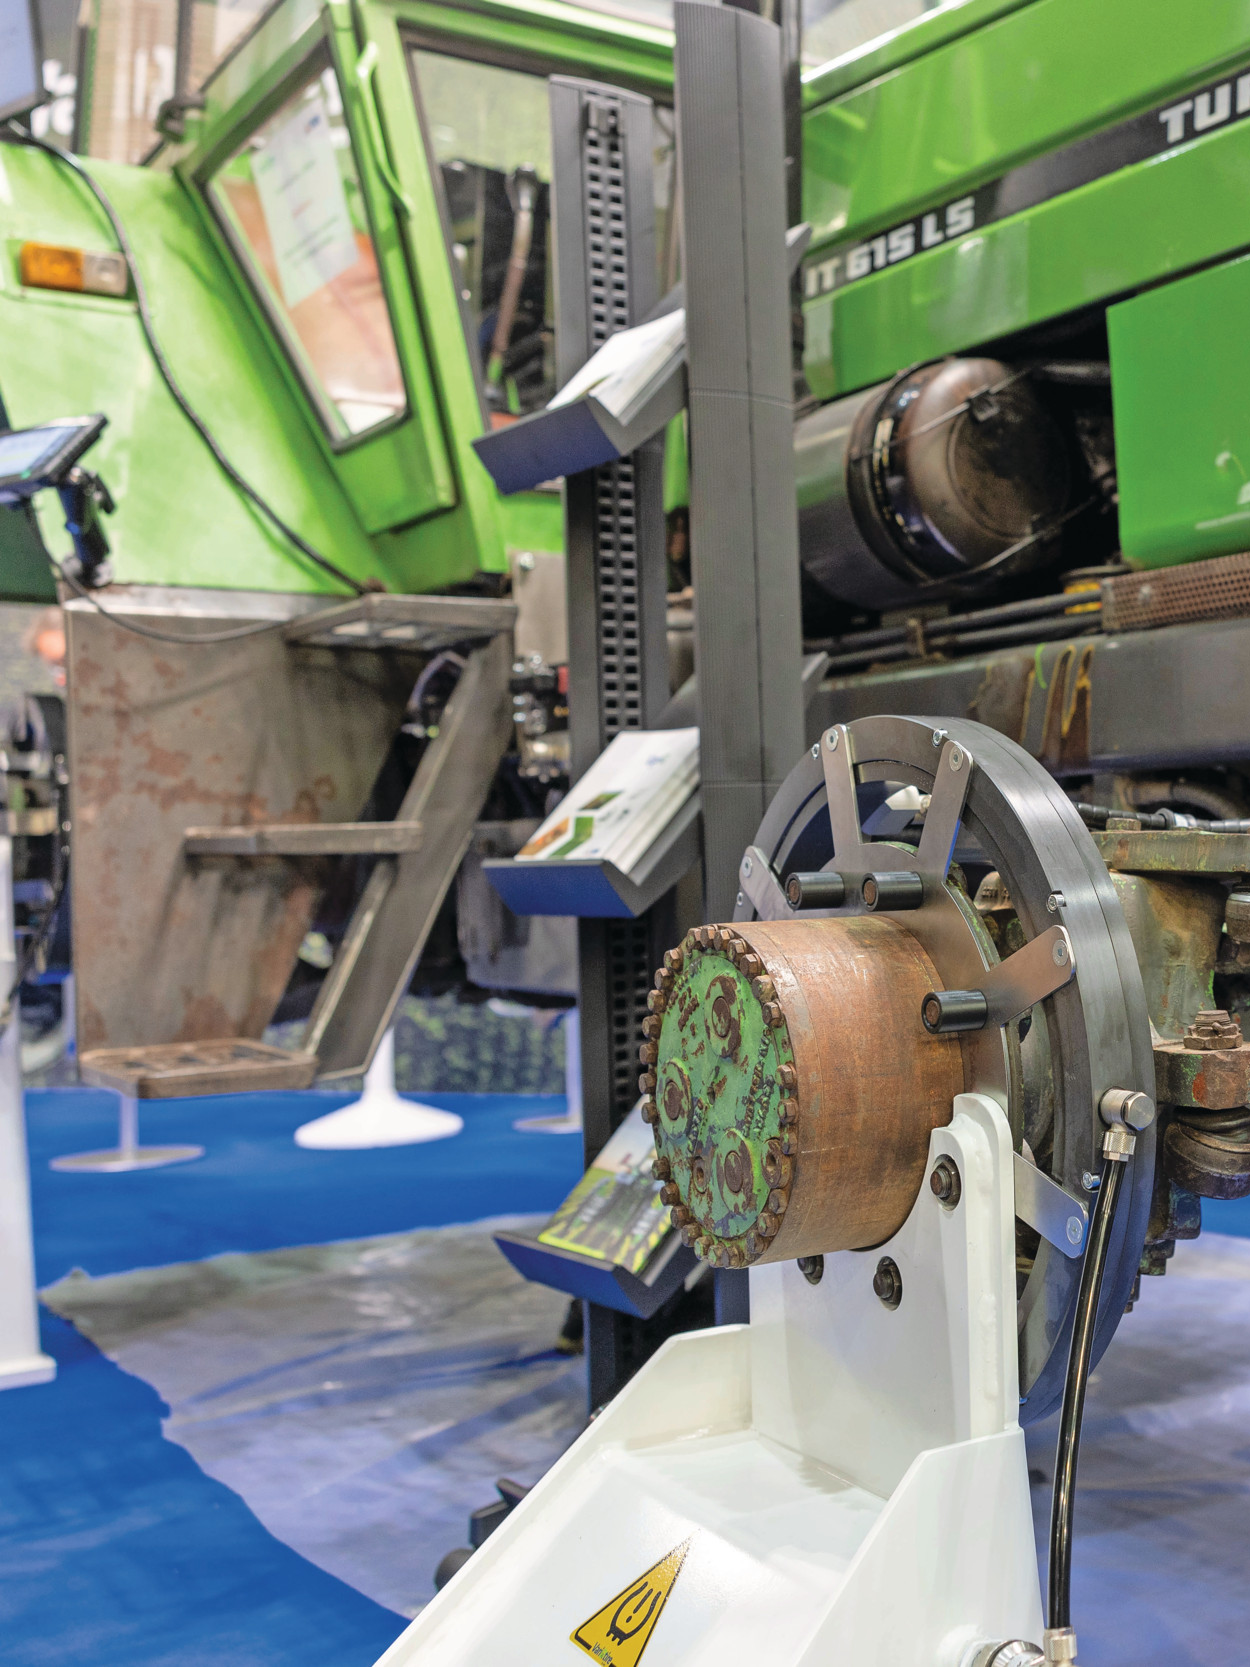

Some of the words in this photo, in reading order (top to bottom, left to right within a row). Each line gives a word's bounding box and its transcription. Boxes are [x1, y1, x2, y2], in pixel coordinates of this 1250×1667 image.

[805, 256, 841, 297] IT
[846, 223, 916, 279] 615
[922, 196, 976, 249] LS
